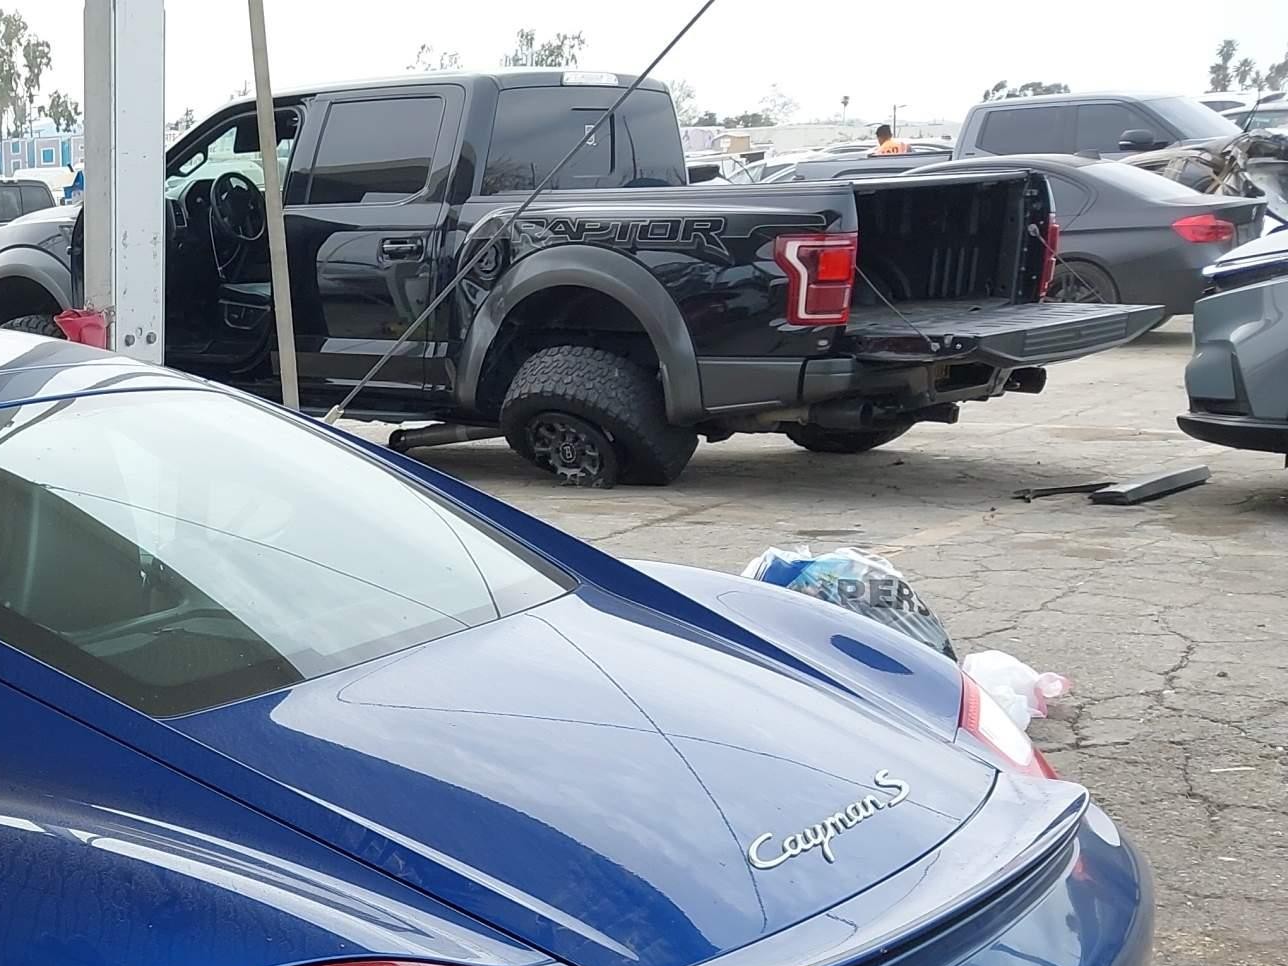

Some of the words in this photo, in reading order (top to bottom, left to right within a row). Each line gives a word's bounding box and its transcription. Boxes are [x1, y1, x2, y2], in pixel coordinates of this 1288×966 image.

[512, 217, 730, 257] RAPTOR
[748, 794, 885, 870] Cayman
[874, 768, 910, 808] S
